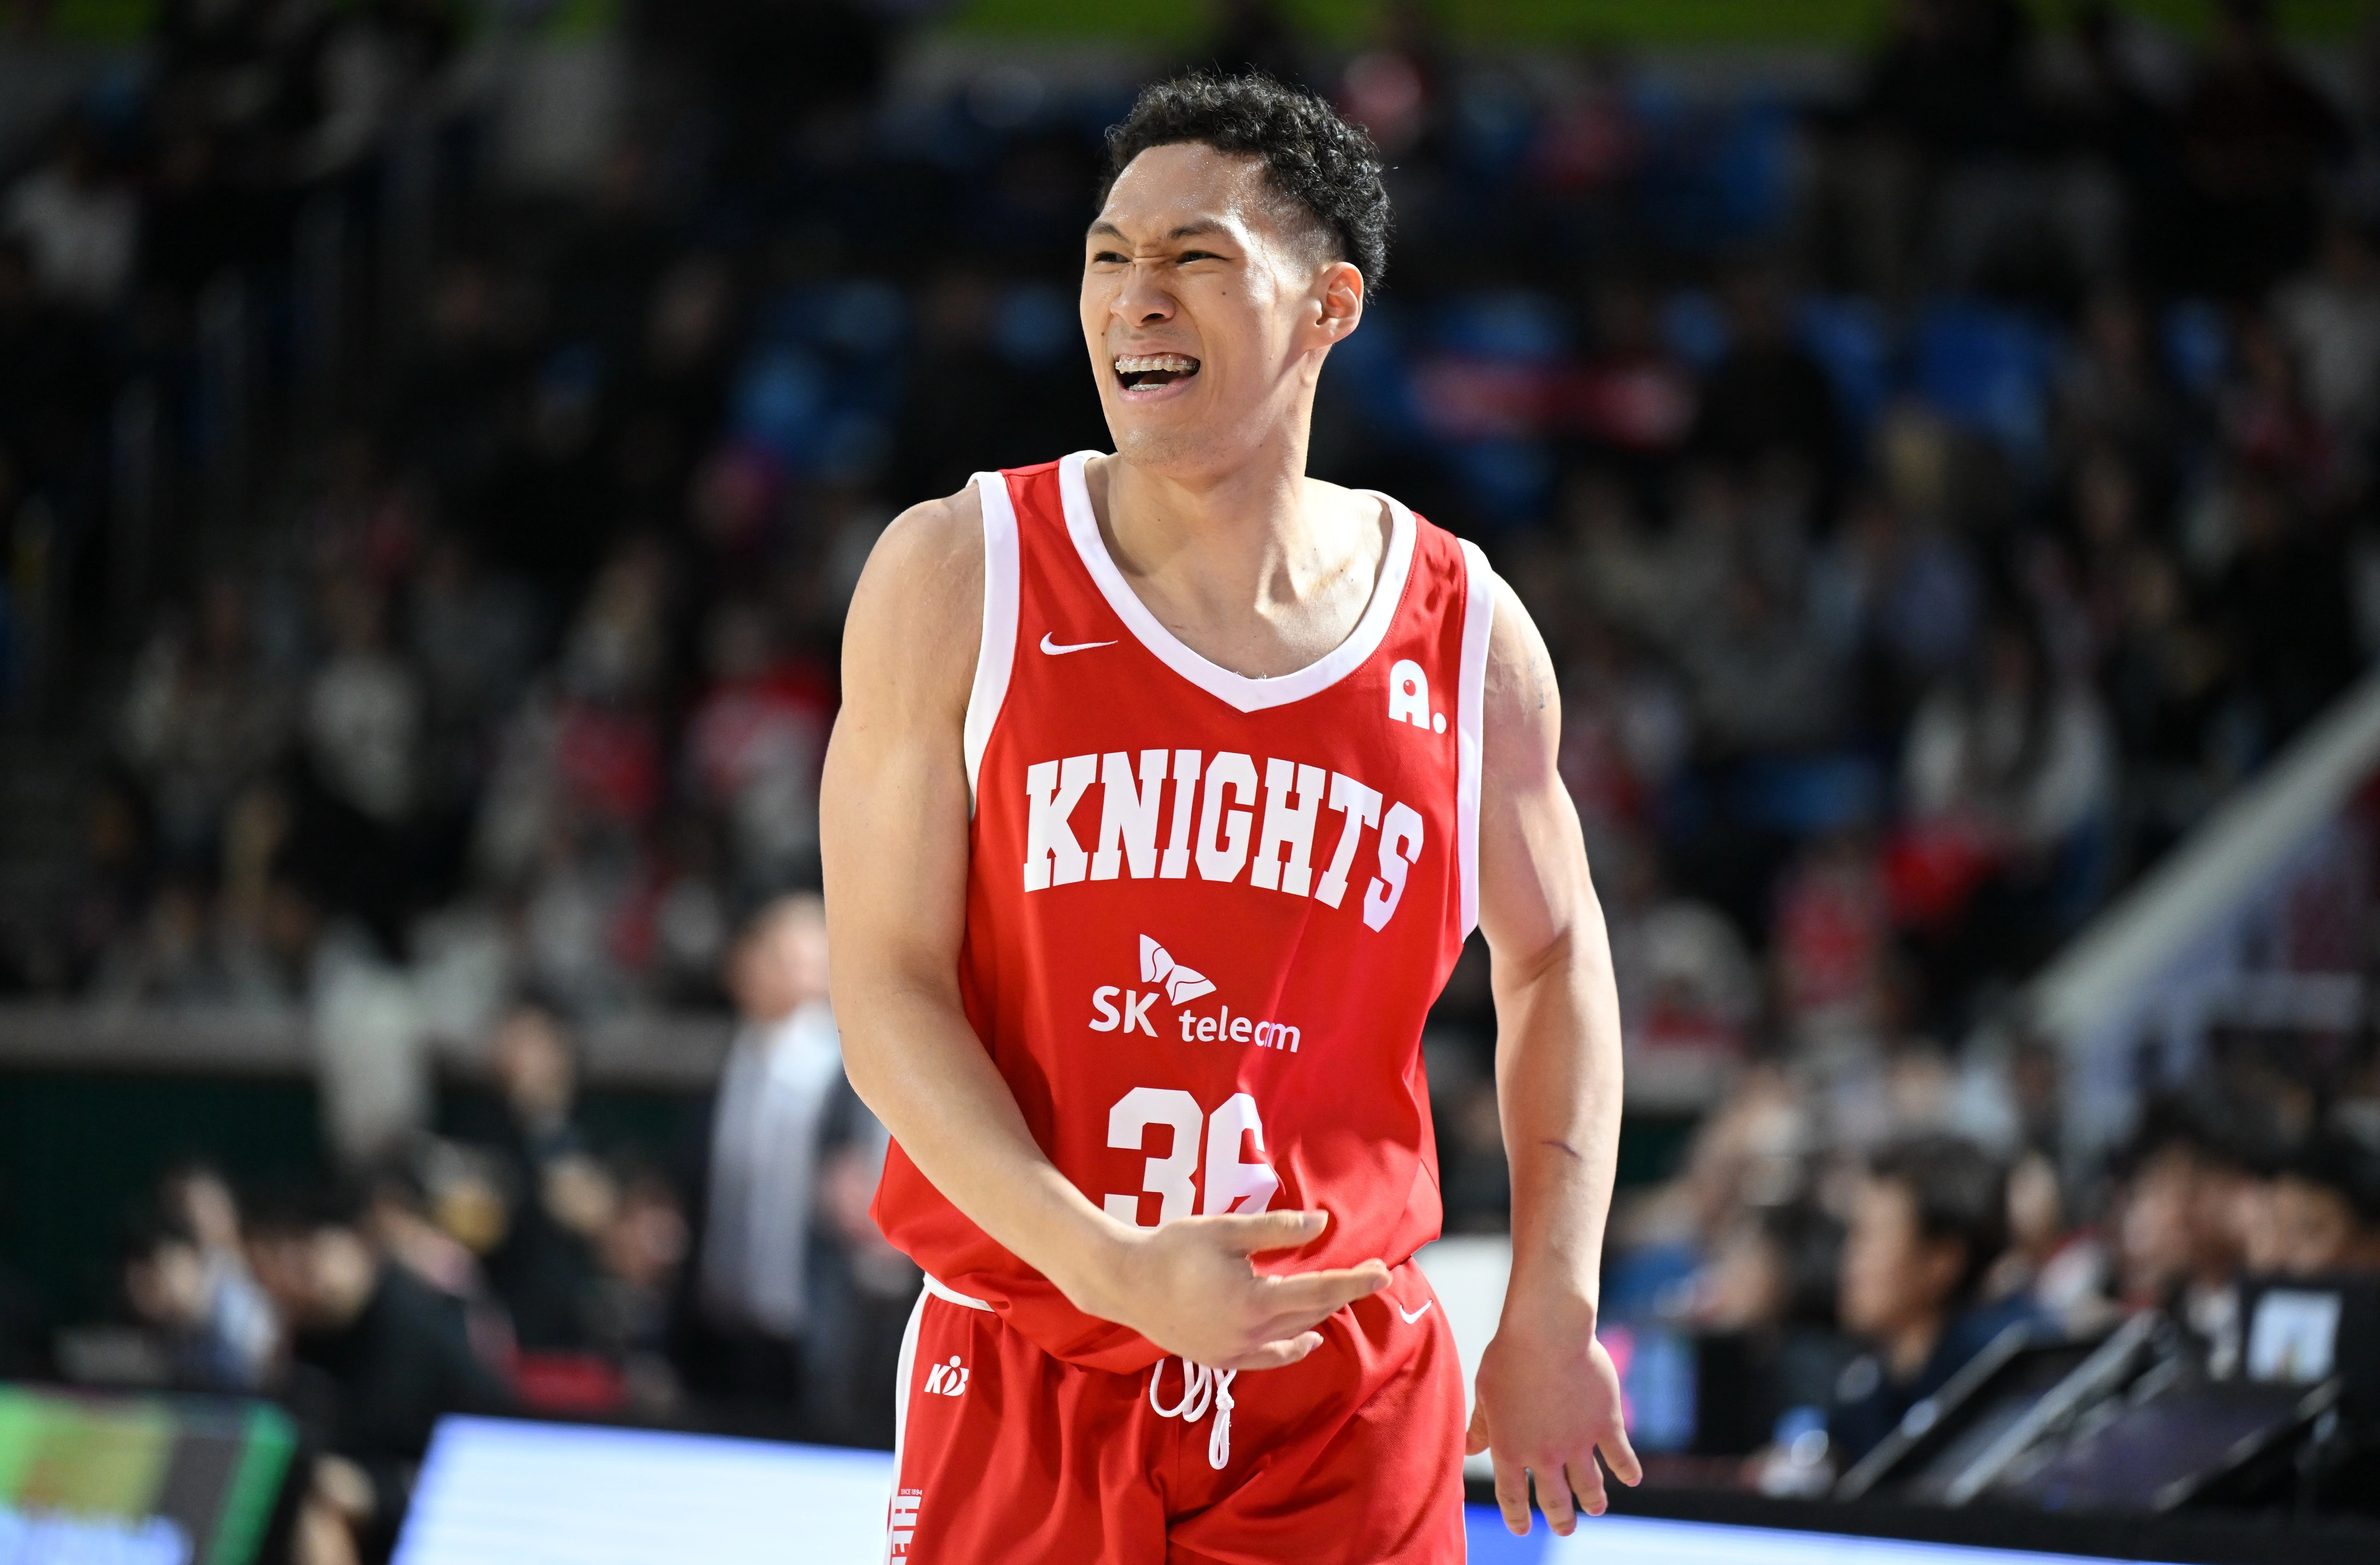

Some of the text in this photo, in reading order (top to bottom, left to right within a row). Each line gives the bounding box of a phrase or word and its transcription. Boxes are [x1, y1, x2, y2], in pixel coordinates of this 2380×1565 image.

[1023, 749, 1424, 933] KNIGHTS
[1089, 986, 1160, 1037] SK
[1103, 1087, 1279, 1228] 36
